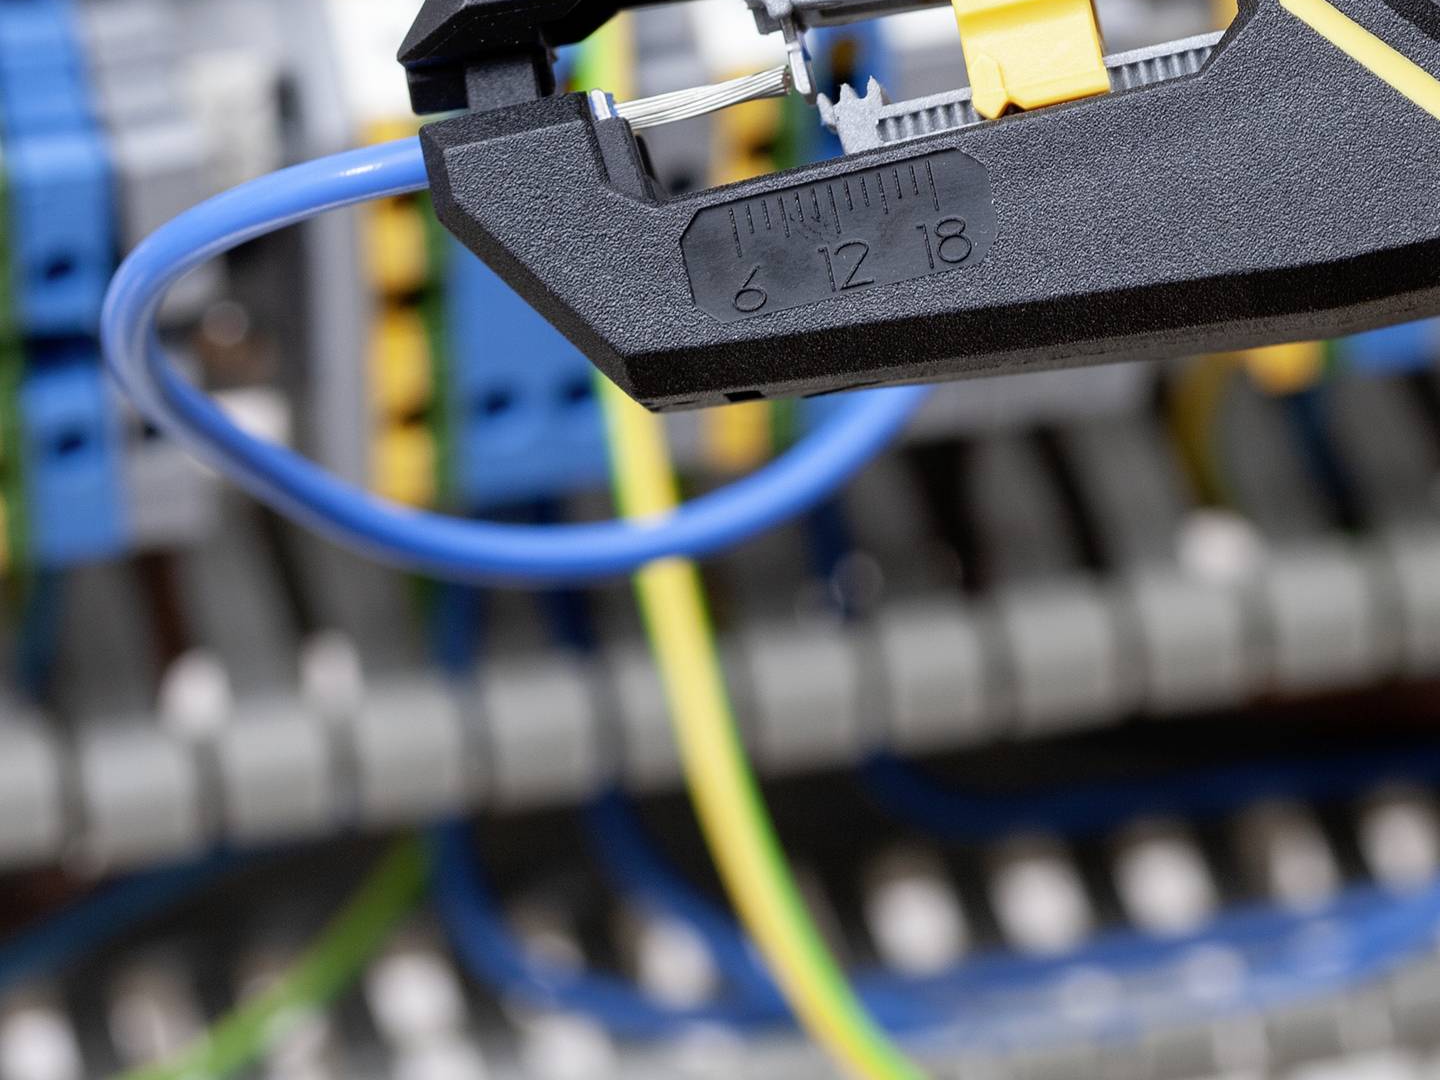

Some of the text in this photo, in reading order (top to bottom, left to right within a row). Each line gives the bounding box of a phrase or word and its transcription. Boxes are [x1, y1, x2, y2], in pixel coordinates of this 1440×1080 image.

[732, 216, 973, 313] 6 12 18
